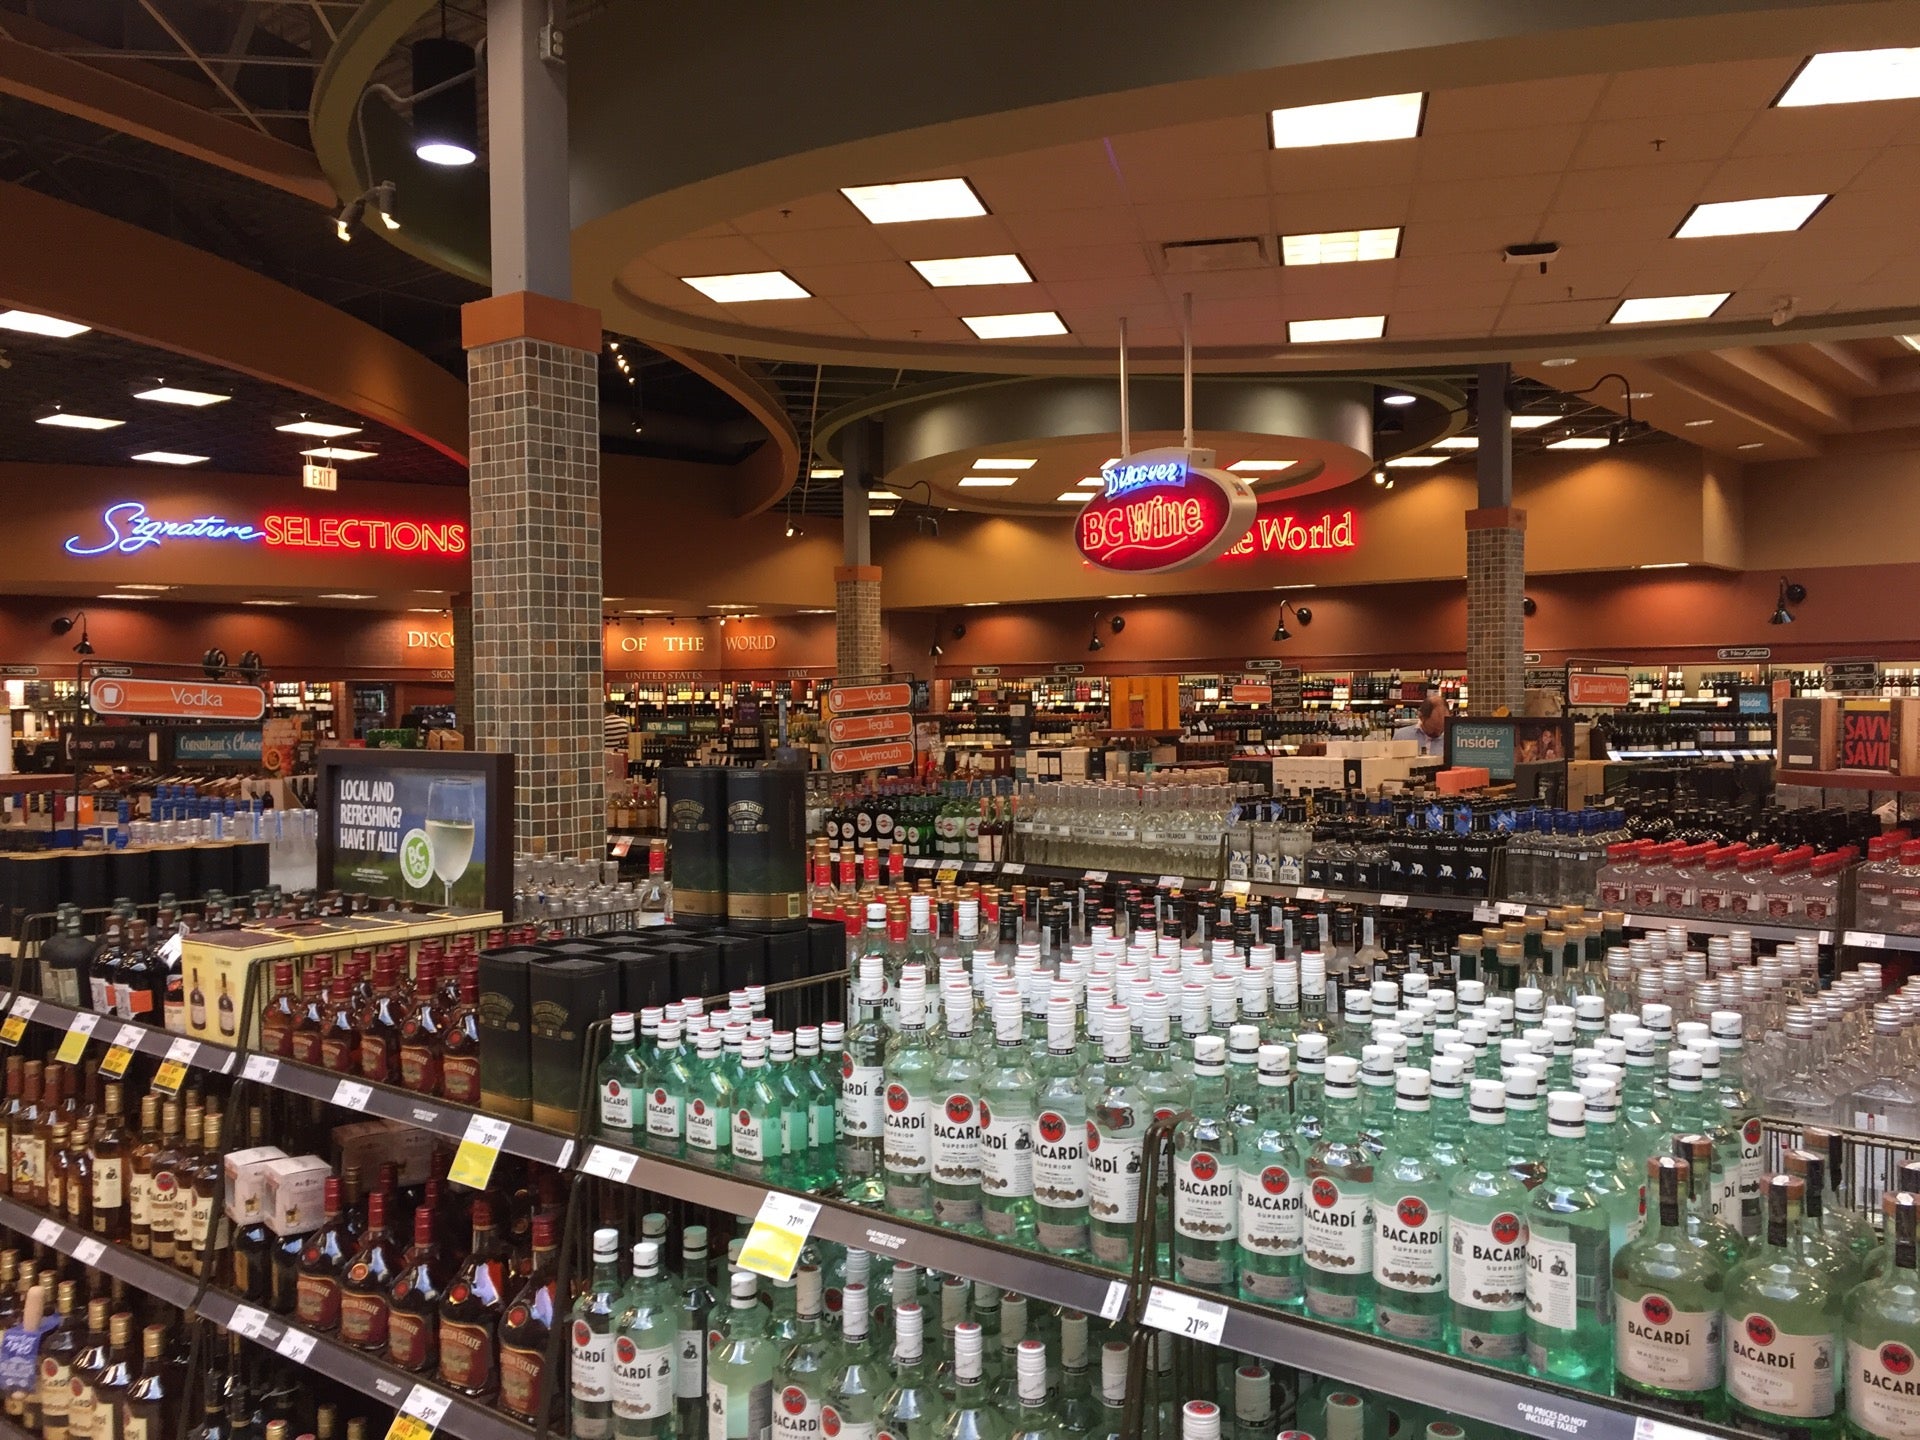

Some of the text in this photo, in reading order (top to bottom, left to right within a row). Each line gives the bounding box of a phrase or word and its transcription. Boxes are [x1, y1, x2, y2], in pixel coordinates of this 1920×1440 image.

[312, 468, 332, 488] EXIT
[1102, 461, 1182, 498] Discover
[65, 502, 466, 554] Signature SELECTIONS
[1083, 495, 1203, 550] BC Wine
[1258, 511, 1354, 551] World
[621, 634, 776, 652] OF THE WORLD
[625, 671, 703, 681] UNITED STATES
[787, 668, 809, 678] ITALY
[170, 687, 223, 707] Vodka
[866, 689, 892, 702] Vodka
[867, 718, 894, 732] Tequila
[1456, 725, 1509, 736] Become an
[180, 735, 233, 751] Consultant's
[1456, 736, 1501, 749] Insider
[859, 747, 902, 762] Vermouth
[340, 779, 394, 803] LOCAL AND
[340, 803, 402, 828] REFRESHING?
[340, 828, 398, 853] HAVE IT ALL!
[407, 842, 425, 865] BC
[933, 1123, 981, 1140] BACARD
[1179, 1179, 1233, 1197] BACARDÍ
[1248, 1192, 1304, 1211] BACARDÍ
[1304, 1203, 1356, 1228] BACARDÍ
[1382, 1224, 1443, 1245] BACARDÍ
[1392, 1245, 1433, 1254] SUPERIOR
[1473, 1244, 1526, 1262] BACARD
[457, 1333, 482, 1351] ESTATE
[1628, 1320, 1692, 1346] BACARDÍ
[1733, 1339, 1797, 1370] BACARDÍ
[514, 1357, 540, 1377] ESTATE
[1517, 1402, 1588, 1428] OUR PRICES DO NOT
[1525, 1412, 1579, 1434] INCLUDE TAXES
